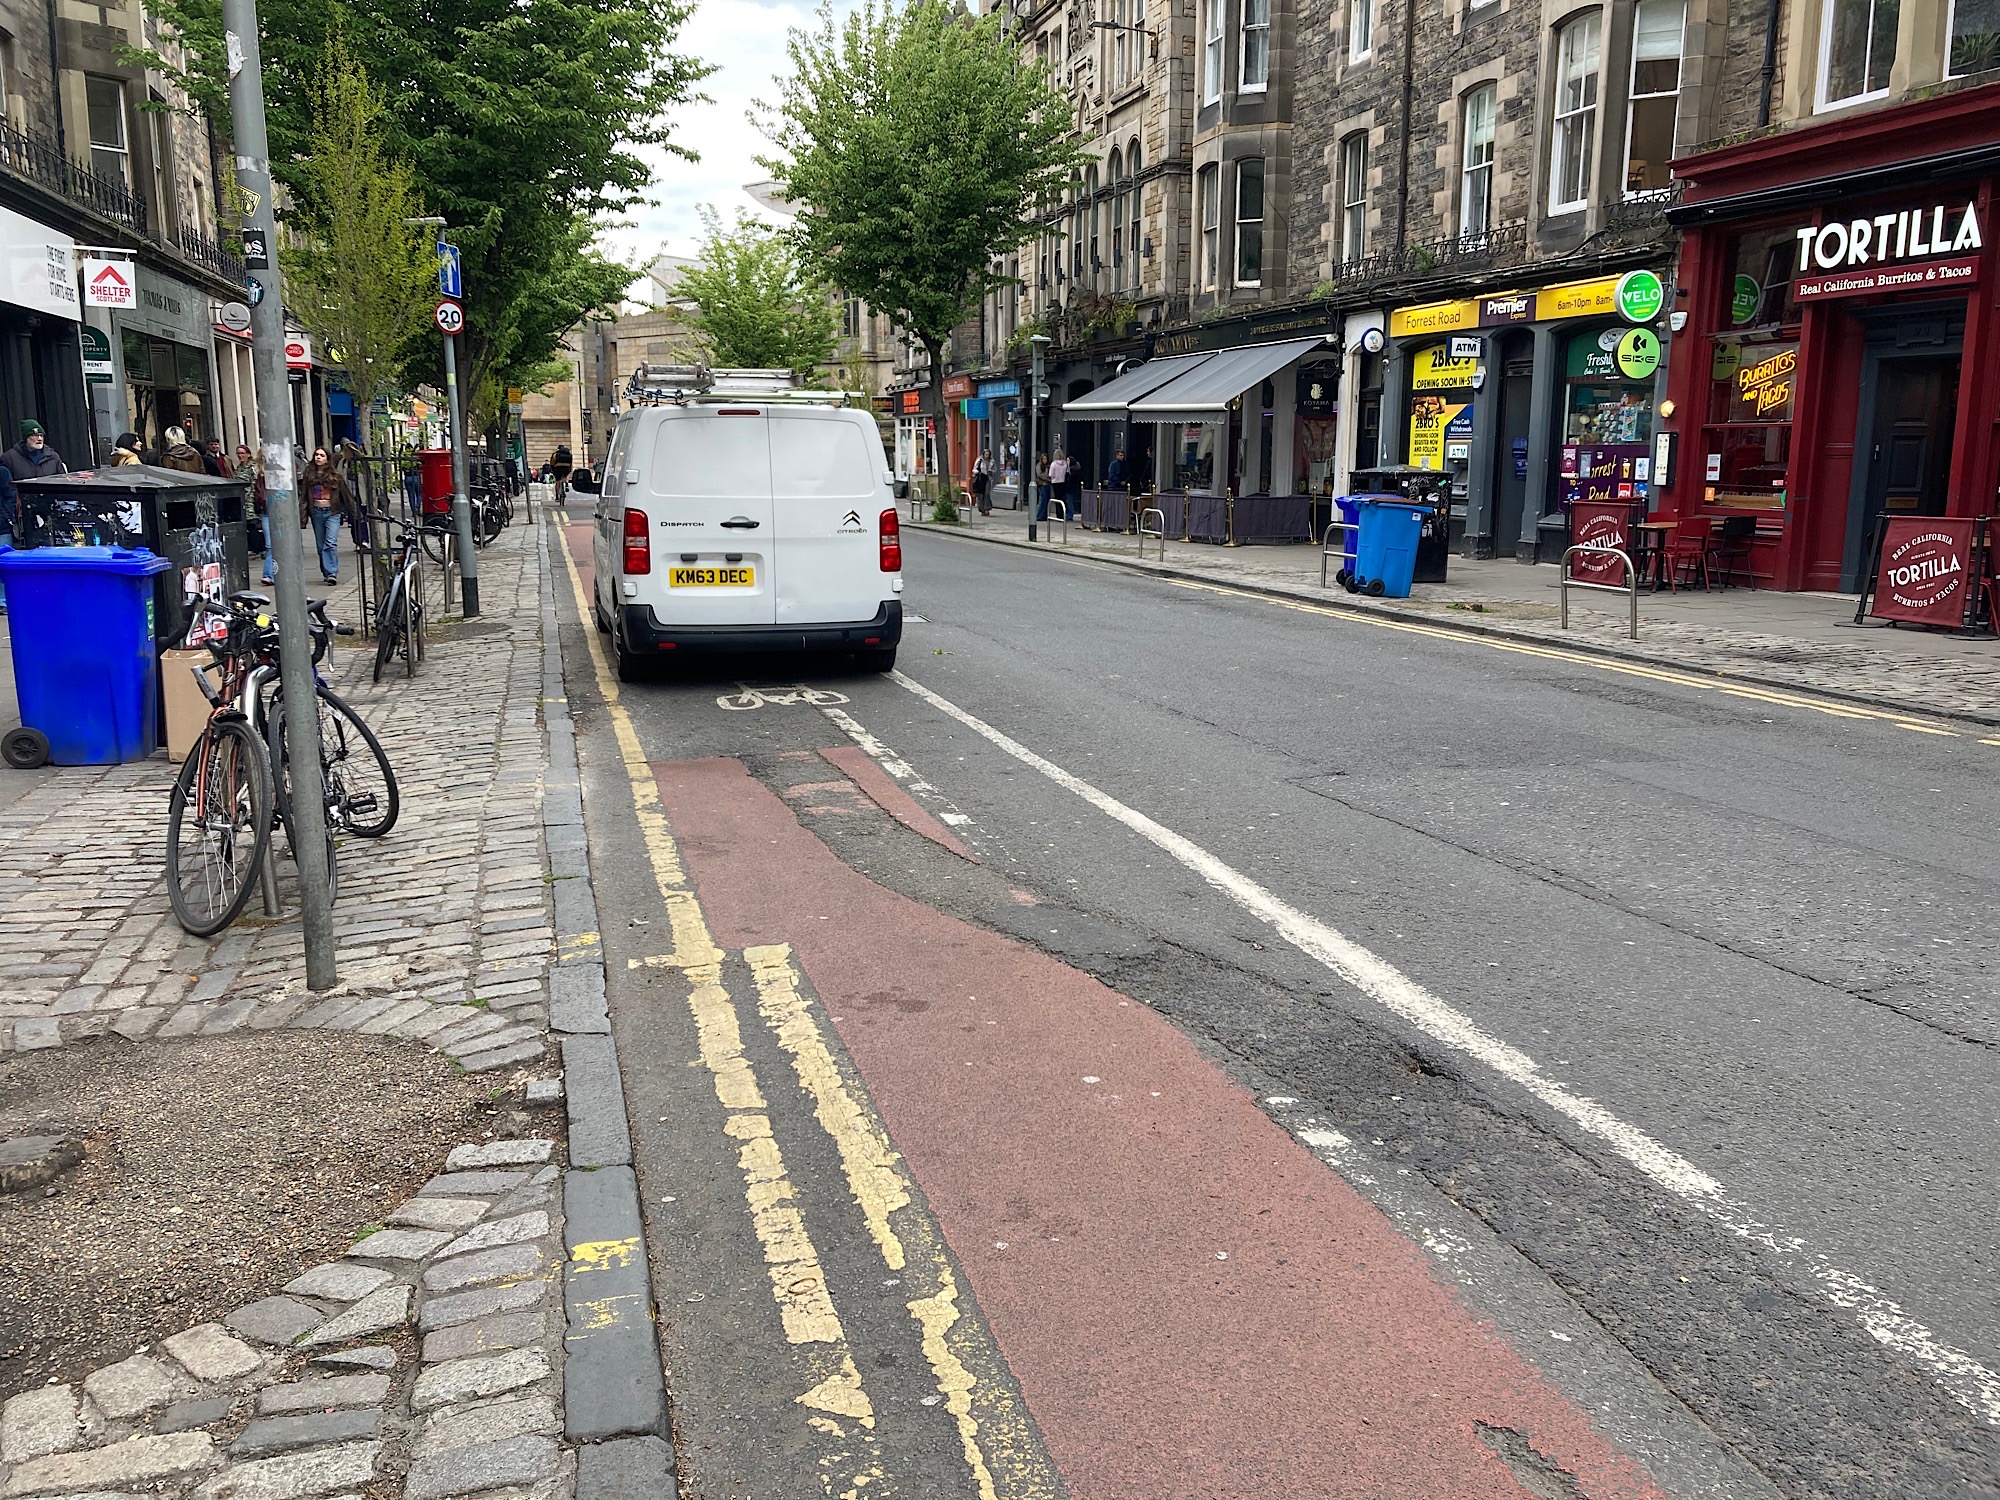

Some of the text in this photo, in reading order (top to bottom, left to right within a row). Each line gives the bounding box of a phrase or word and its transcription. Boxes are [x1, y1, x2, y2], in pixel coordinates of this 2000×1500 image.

[1797, 201, 1982, 271] TORTILLA
[1800, 266, 1972, 296] Real California Burritos & Tacos
[90, 285, 131, 297] SHELTER
[1623, 289, 1660, 303] VELO
[96, 295, 126, 303] SCOTLAND
[1557, 295, 1613, 310] 6am-10pm 8am-
[1487, 299, 1528, 315] Premier
[439, 309, 461, 324] 20
[1406, 308, 1461, 329] Forrest Road
[1456, 343, 1477, 352] ATM
[1431, 350, 1471, 368] 2BROS
[1740, 351, 1797, 392] BURRITOS
[1416, 376, 1473, 389] OPENING SOON IN-ST
[1755, 381, 1791, 416] TACOS
[1415, 417, 1439, 429] 2BRO'S
[1452, 448, 1466, 456] ATM
[1591, 455, 1617, 479] orrest
[1590, 515, 1618, 525] CALIFORNIA
[1892, 533, 1953, 560] REAL CALIFORNIA
[676, 570, 748, 584] KM63 DEC
[1887, 553, 1961, 587] TORTILLA
[1893, 593, 1928, 608] BURRITOS
[1929, 597, 1935, 605] &
[1935, 578, 1959, 601] TACOS
